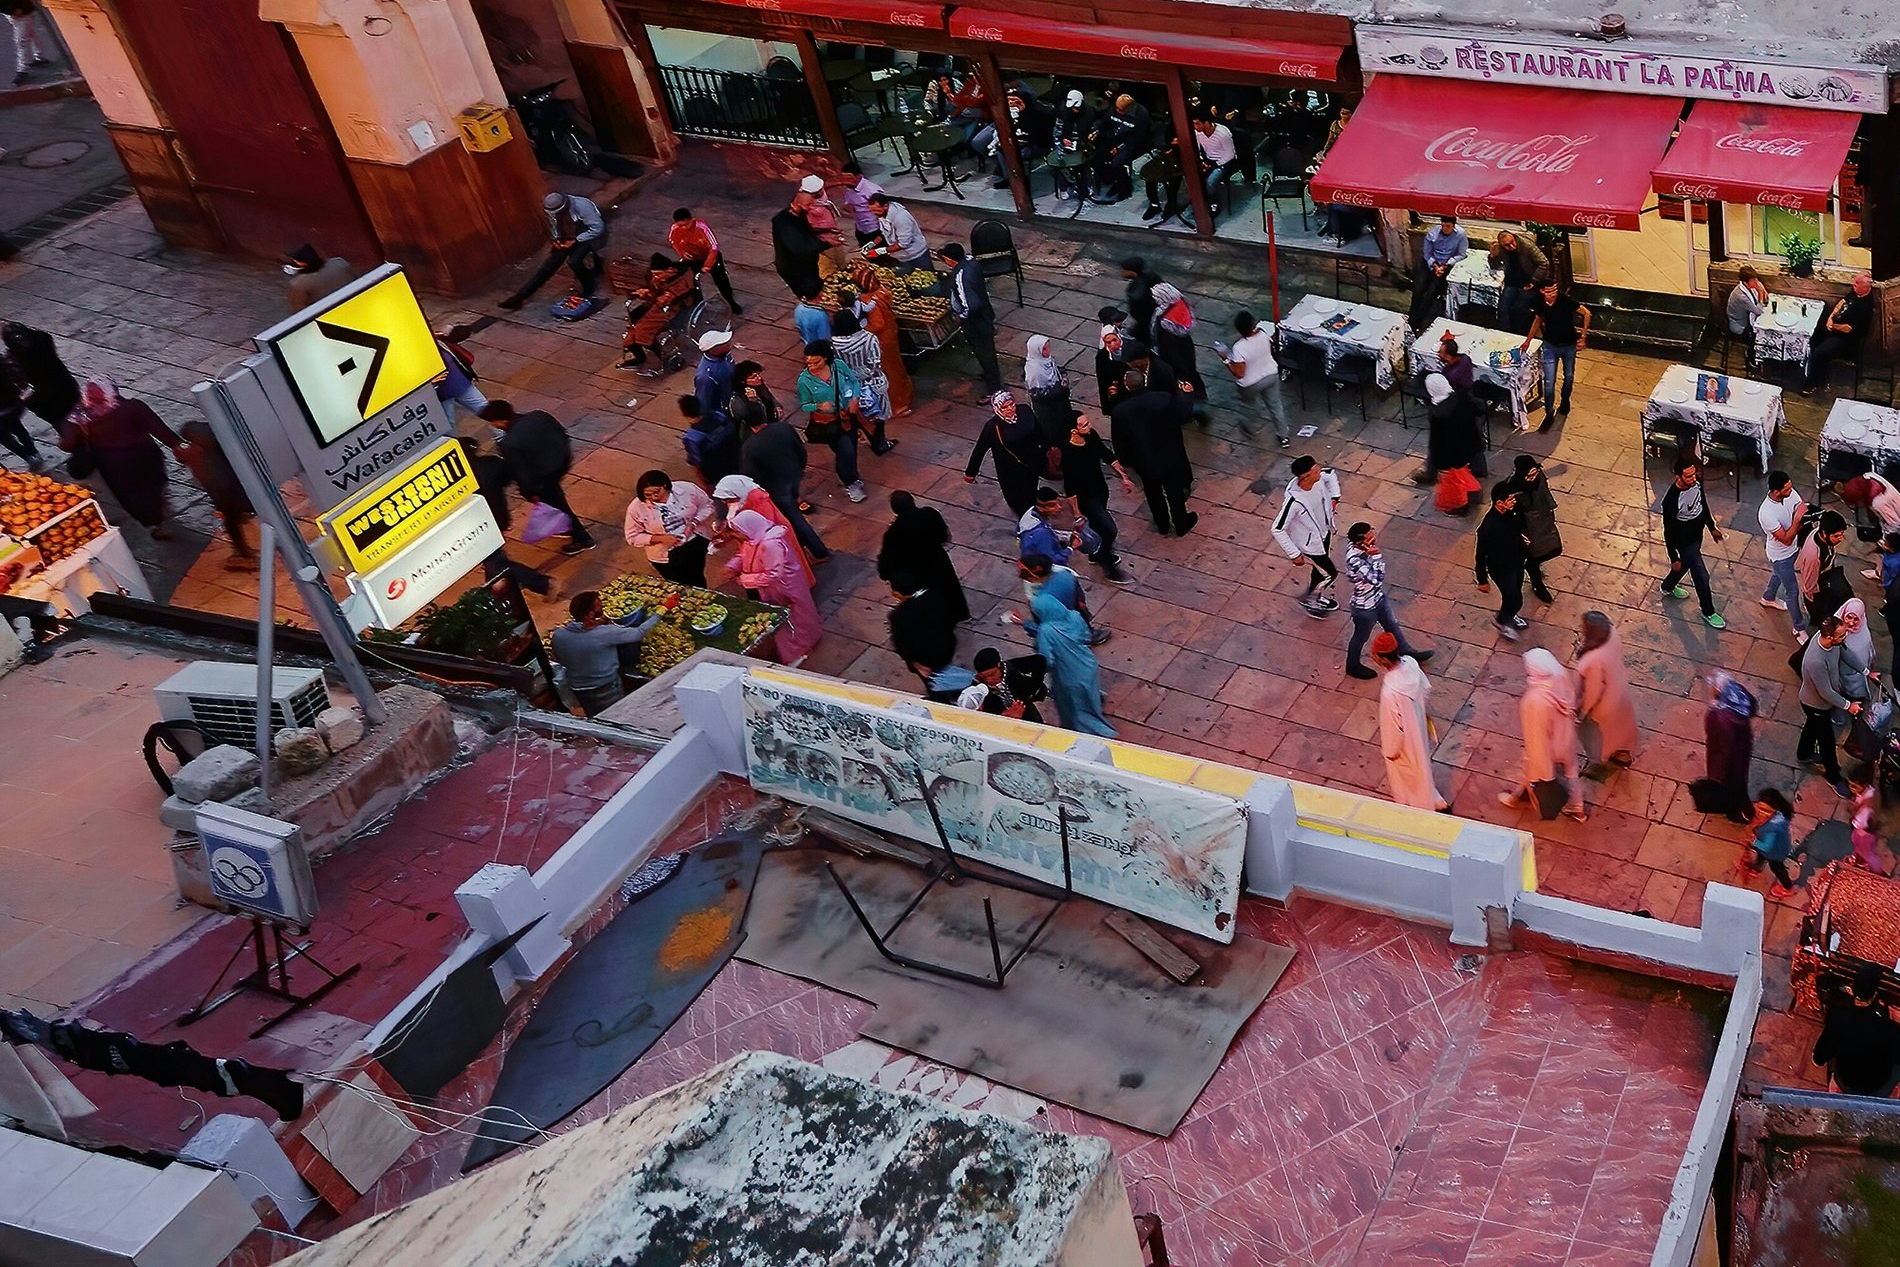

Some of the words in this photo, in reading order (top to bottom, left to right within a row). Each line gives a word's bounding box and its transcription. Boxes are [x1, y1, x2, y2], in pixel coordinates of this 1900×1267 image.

[1455, 47, 1629, 83] RESTAURANT
[1640, 63, 1676, 87] LA
[1684, 67, 1776, 94] PALMA
[332, 420, 437, 491] Wafacash
[348, 462, 446, 537] WESTERN
[384, 480, 449, 526] UNION
[366, 519, 423, 562] TRANSFERT
[411, 521, 489, 583] MoneyGram
[1081, 830, 1134, 856] CHEZ
